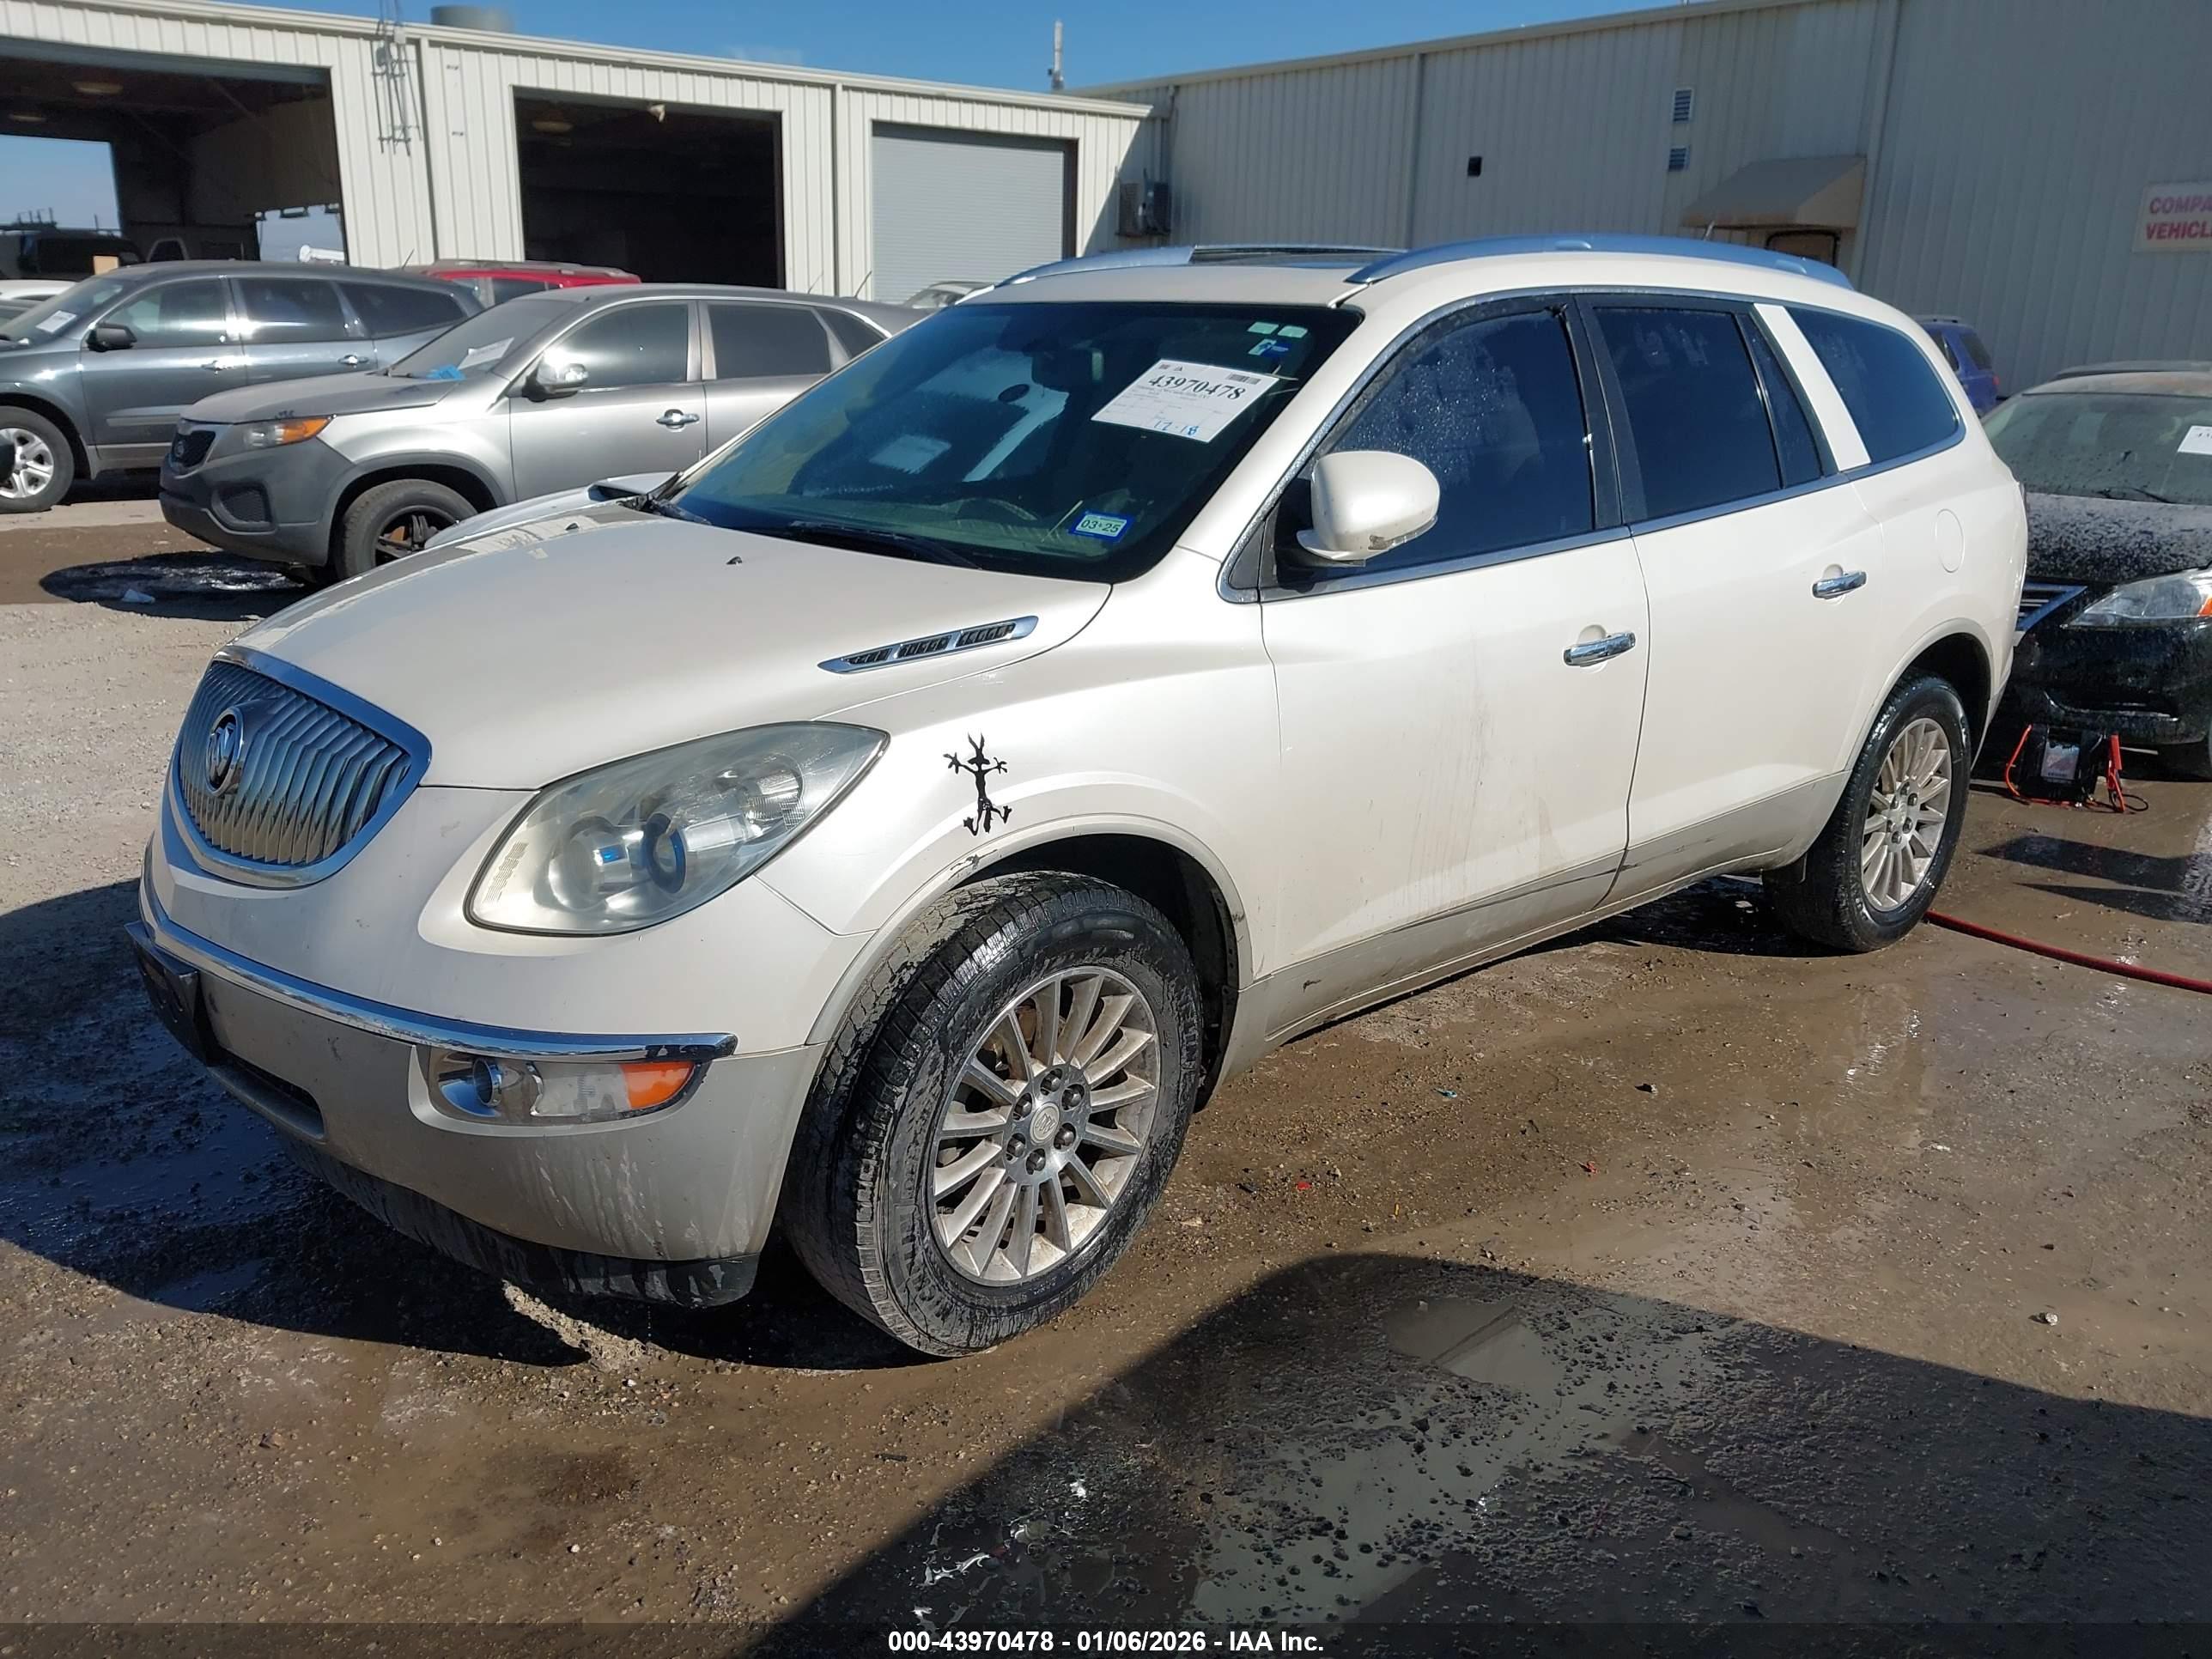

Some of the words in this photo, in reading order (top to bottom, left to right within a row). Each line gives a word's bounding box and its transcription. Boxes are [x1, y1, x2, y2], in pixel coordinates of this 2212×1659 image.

[2147, 220, 2212, 240] VEHICL
[1149, 374, 1246, 399] 43970478
[1080, 520, 1098, 530] 03
[1102, 522, 1121, 533] 25
